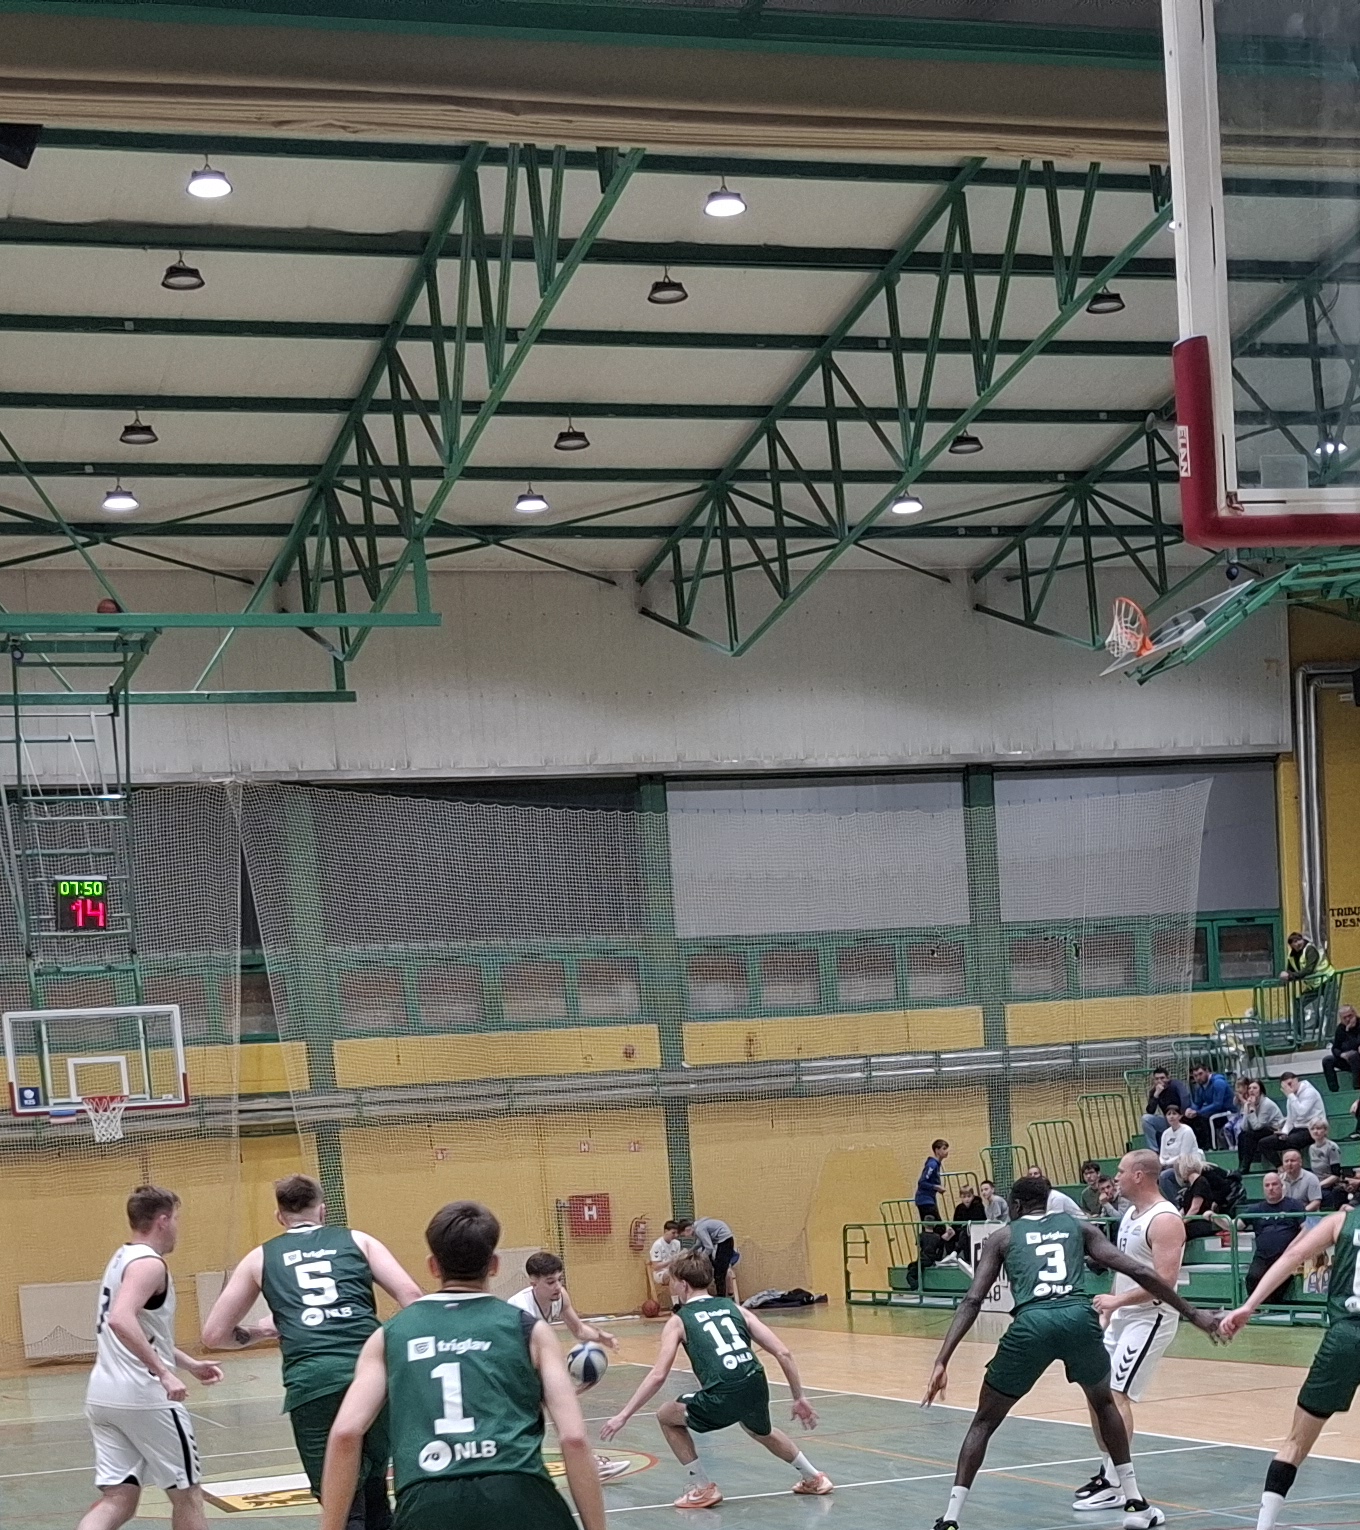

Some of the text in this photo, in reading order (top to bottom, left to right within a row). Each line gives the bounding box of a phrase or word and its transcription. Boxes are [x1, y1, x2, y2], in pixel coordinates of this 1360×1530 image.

[60, 881, 103, 896] 07:50
[70, 898, 106, 928] 14
[583, 1205, 598, 1221] H
[1035, 1242, 1068, 1282] 3
[294, 1260, 339, 1307] 5
[324, 1306, 353, 1319] NLB
[436, 1337, 492, 1354] triglav
[702, 1316, 748, 1357] 11
[430, 1361, 476, 1435] 1
[454, 1439, 498, 1461] NLB
